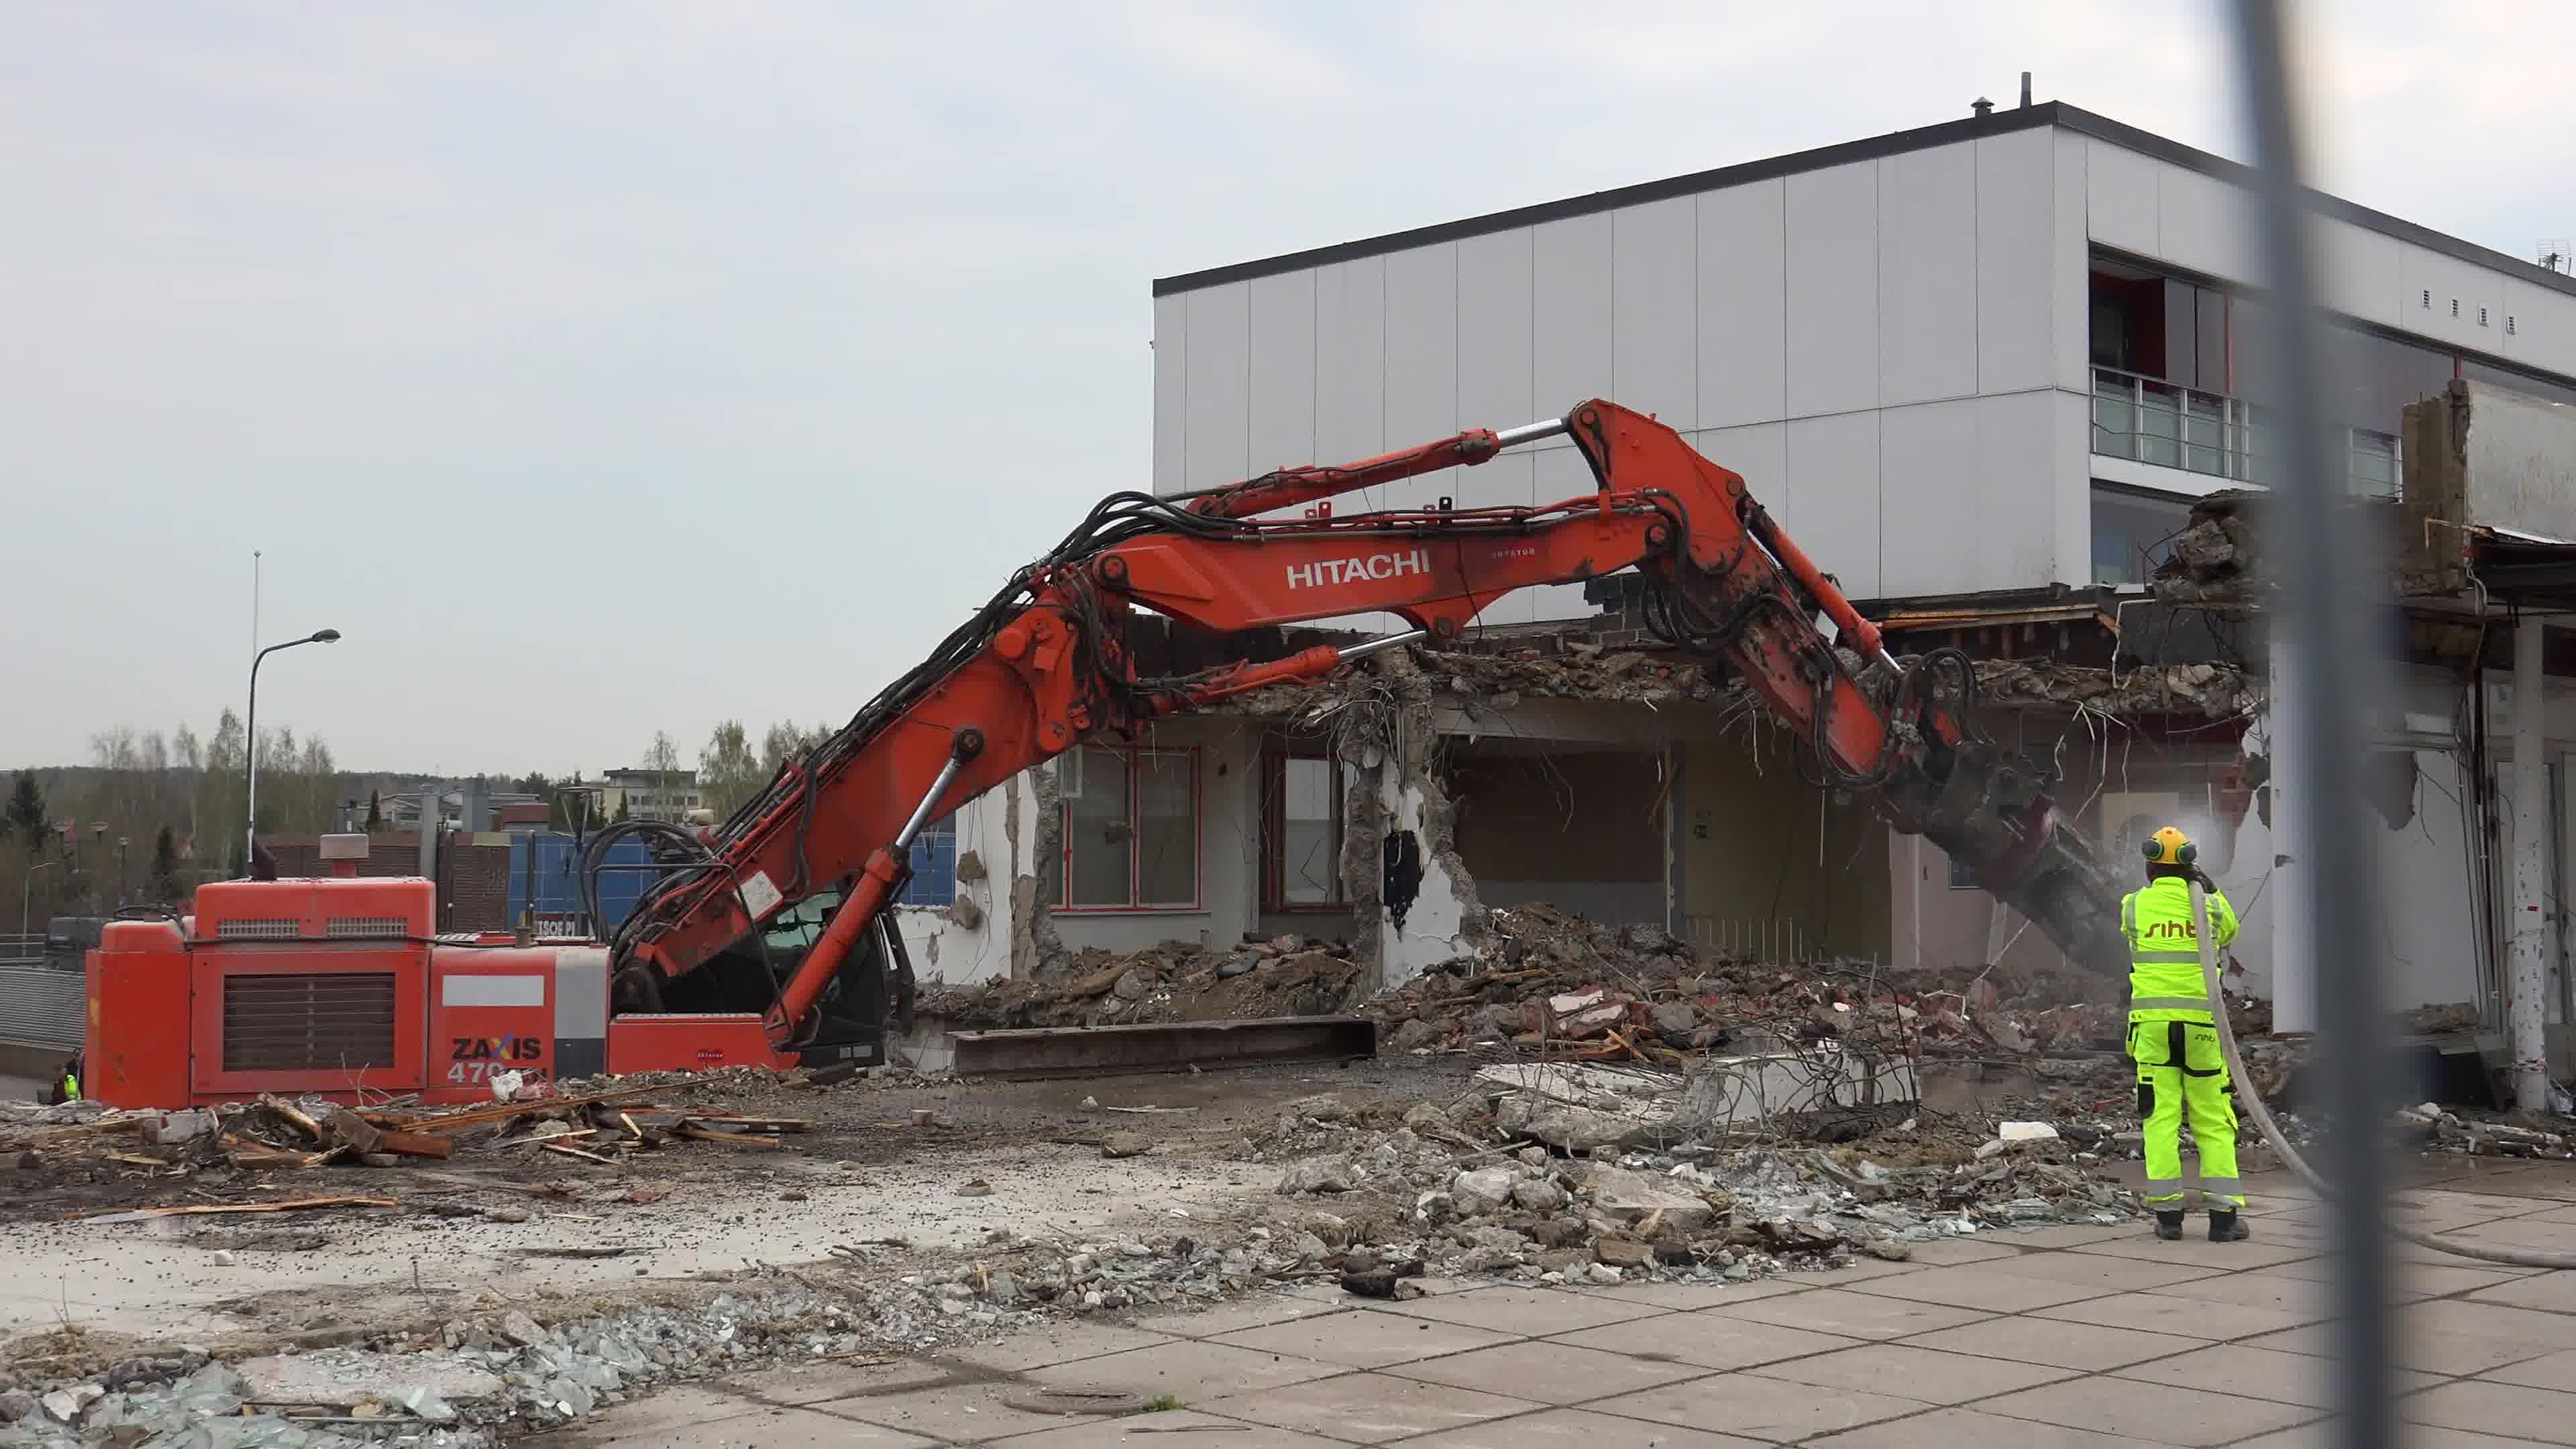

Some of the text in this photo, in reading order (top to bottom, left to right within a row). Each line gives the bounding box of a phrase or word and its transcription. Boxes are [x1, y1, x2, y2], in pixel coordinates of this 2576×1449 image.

[1286, 548, 1430, 590] HITACHI
[2145, 920, 2196, 938] siht
[451, 1030, 542, 1059] ZAXIS
